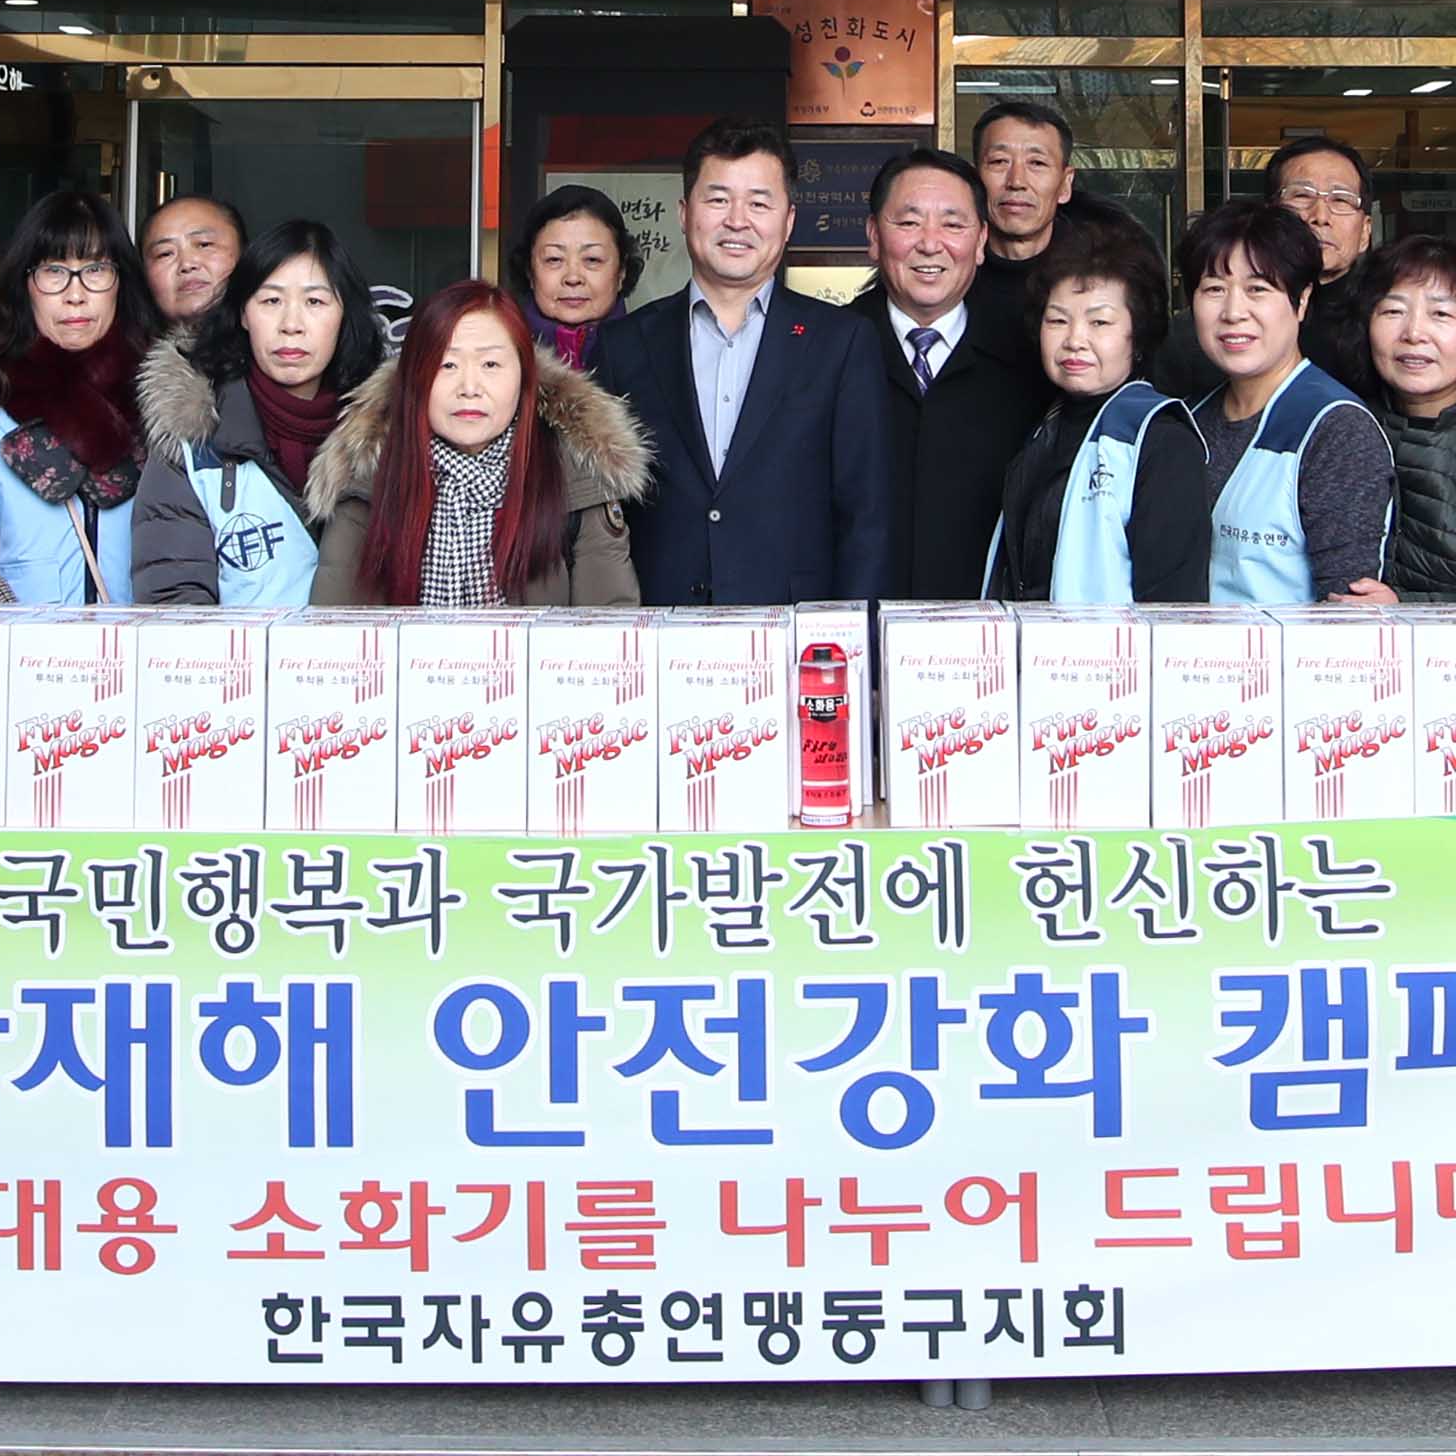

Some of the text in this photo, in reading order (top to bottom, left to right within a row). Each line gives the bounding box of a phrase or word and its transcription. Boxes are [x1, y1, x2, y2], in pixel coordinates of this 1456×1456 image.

[620, 198, 666, 223] 변화
[632, 229, 672, 260] 복한
[216, 521, 285, 568] KFF
[1219, 523, 1290, 546] 한국자유총연맹
[19, 655, 44, 668] Fire
[147, 656, 172, 669] Fire
[279, 656, 304, 669] Fire
[410, 656, 435, 669] Fire
[540, 657, 565, 670] Fire
[669, 657, 694, 670] Fire
[900, 652, 925, 665] Fire
[1033, 654, 1058, 667] Fire
[1165, 655, 1190, 668] Fire
[1297, 655, 1322, 668] Fire
[1426, 655, 1451, 668] Fire
[15, 710, 82, 753] Fire
[31, 714, 126, 777] Magic
[144, 711, 211, 754] Fire
[160, 715, 255, 778] Magic
[276, 711, 343, 754] Fire
[292, 715, 387, 778] Magic
[407, 712, 474, 755] Fire
[423, 716, 518, 779] Magic
[537, 713, 604, 756] Fire
[553, 717, 648, 780] Magic
[668, 712, 735, 755] Fire
[684, 716, 779, 779] Magic
[899, 707, 966, 750] Fire
[915, 711, 1010, 774] Magic
[1031, 708, 1098, 751] Fire
[1047, 712, 1142, 775] Magic
[1163, 710, 1230, 753] Fire
[1179, 714, 1274, 777] Magic
[1296, 710, 1363, 753] Fire
[1312, 714, 1407, 777] Magic
[496, 841, 966, 955] 국가발전에
[1017, 835, 1392, 944] 헌신하는
[432, 972, 1149, 1149] 안전강화
[226, 1177, 667, 1273] 소화기를
[719, 1171, 1039, 1269] 나누어
[261, 1283, 1126, 1367] 한국자유총연맹동구지회
